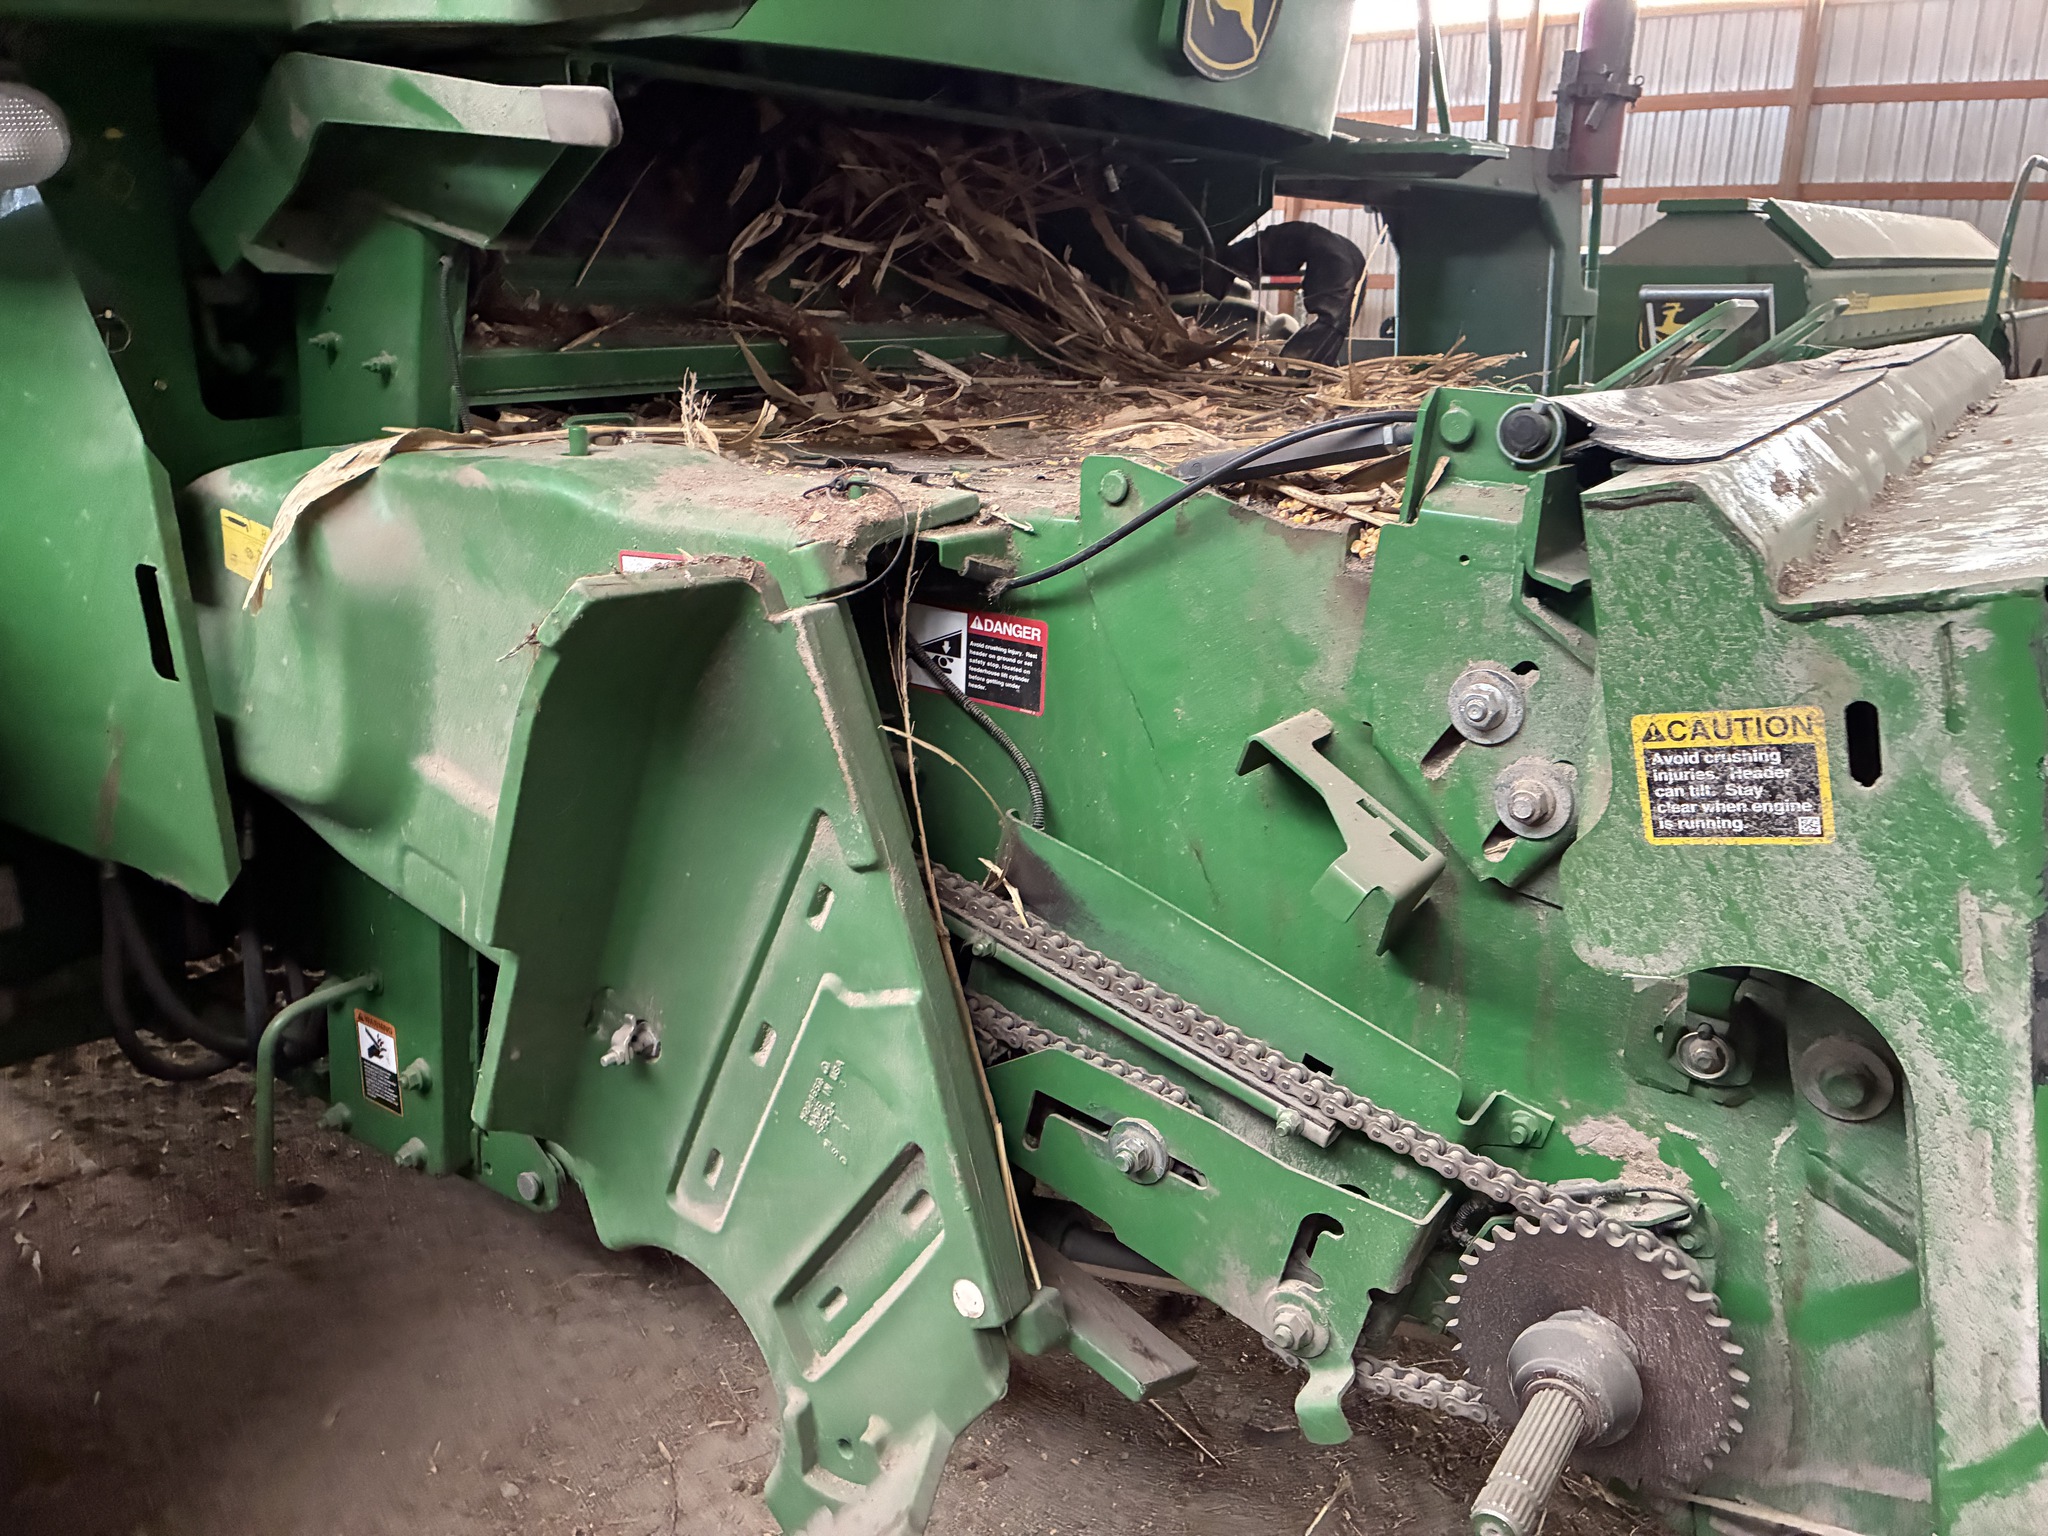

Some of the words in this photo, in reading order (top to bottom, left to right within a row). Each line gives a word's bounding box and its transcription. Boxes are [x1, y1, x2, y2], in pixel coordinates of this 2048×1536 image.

[984, 619, 1041, 641] DANGER
[969, 641, 985, 649] Avoid
[985, 644, 1007, 654] crushing
[1008, 648, 1024, 657] injury.
[1025, 651, 1038, 659] Rest
[969, 649, 988, 657] header
[996, 655, 1016, 664] ground
[969, 658, 986, 666] safety
[986, 661, 1001, 669] stop,
[1002, 664, 1022, 673] located
[968, 666, 1000, 677] feederhouse
[1009, 674, 1030, 683] cylinder
[968, 674, 985, 682] before
[986, 677, 1004, 687] getting
[968, 682, 987, 690] header.
[1667, 714, 1814, 742] CAUTION
[1652, 751, 1699, 766] Avoid
[1704, 750, 1781, 765] crushing
[1654, 769, 1720, 784] injuries.
[1730, 767, 1792, 780] Header
[1654, 787, 1685, 798] can
[1689, 785, 1716, 798] tilt.
[1725, 784, 1764, 800] Stay
[1656, 800, 1698, 814] clear
[1702, 801, 1748, 814] when
[1752, 799, 1813, 815] engine
[1659, 817, 1674, 830] is
[1678, 815, 1749, 832] running.
